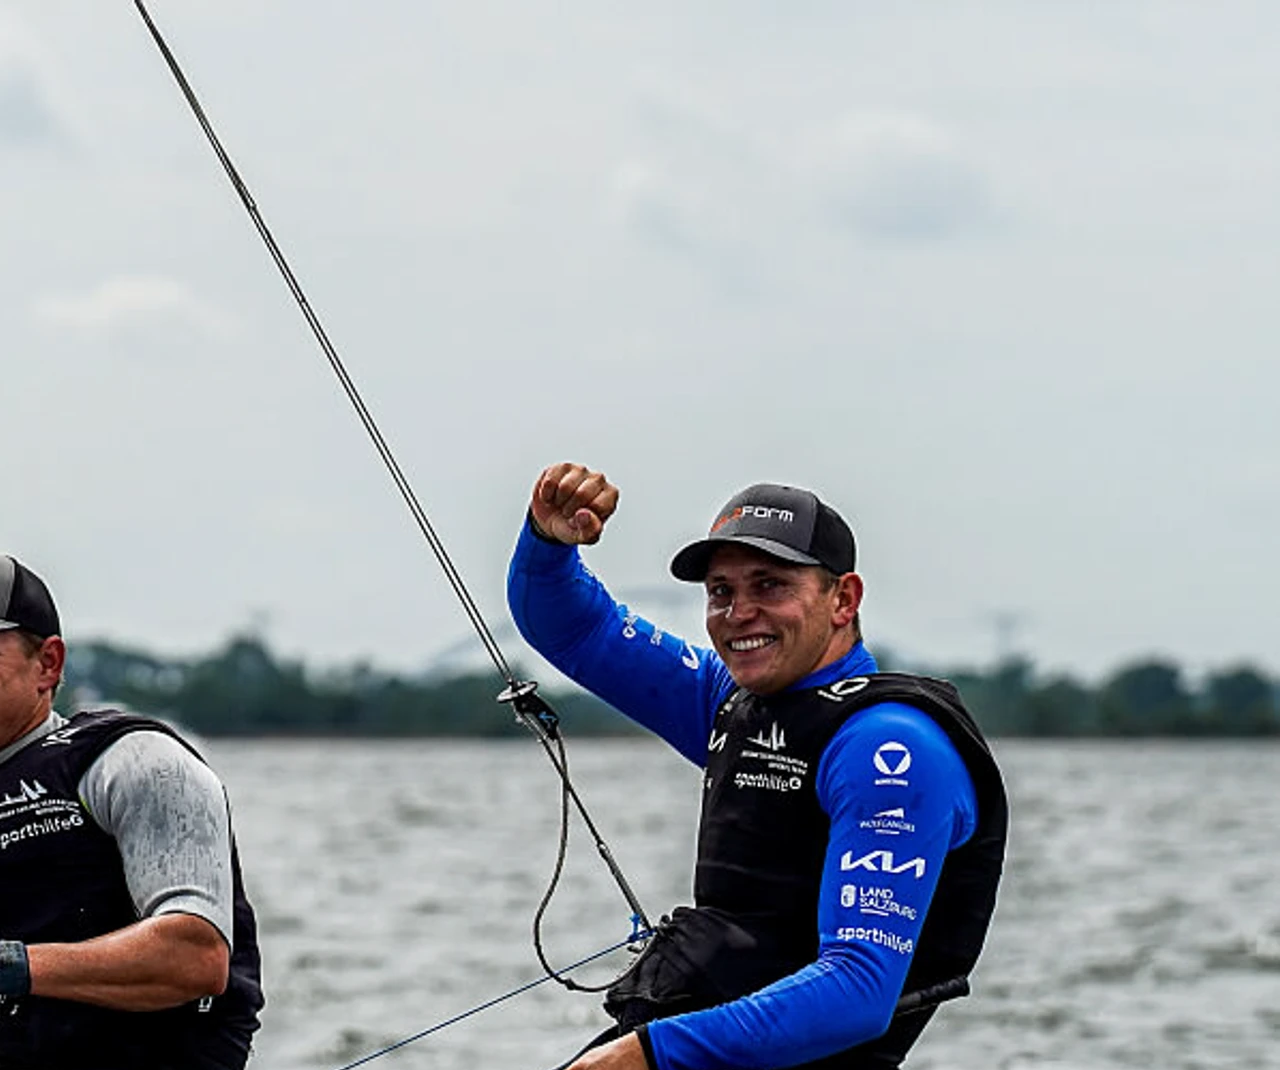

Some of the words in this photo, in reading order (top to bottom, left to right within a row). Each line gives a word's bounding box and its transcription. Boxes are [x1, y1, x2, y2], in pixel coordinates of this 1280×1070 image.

[840, 850, 926, 879] KIA
[860, 886, 894, 899] LAND
[860, 897, 918, 920] SALZBURG
